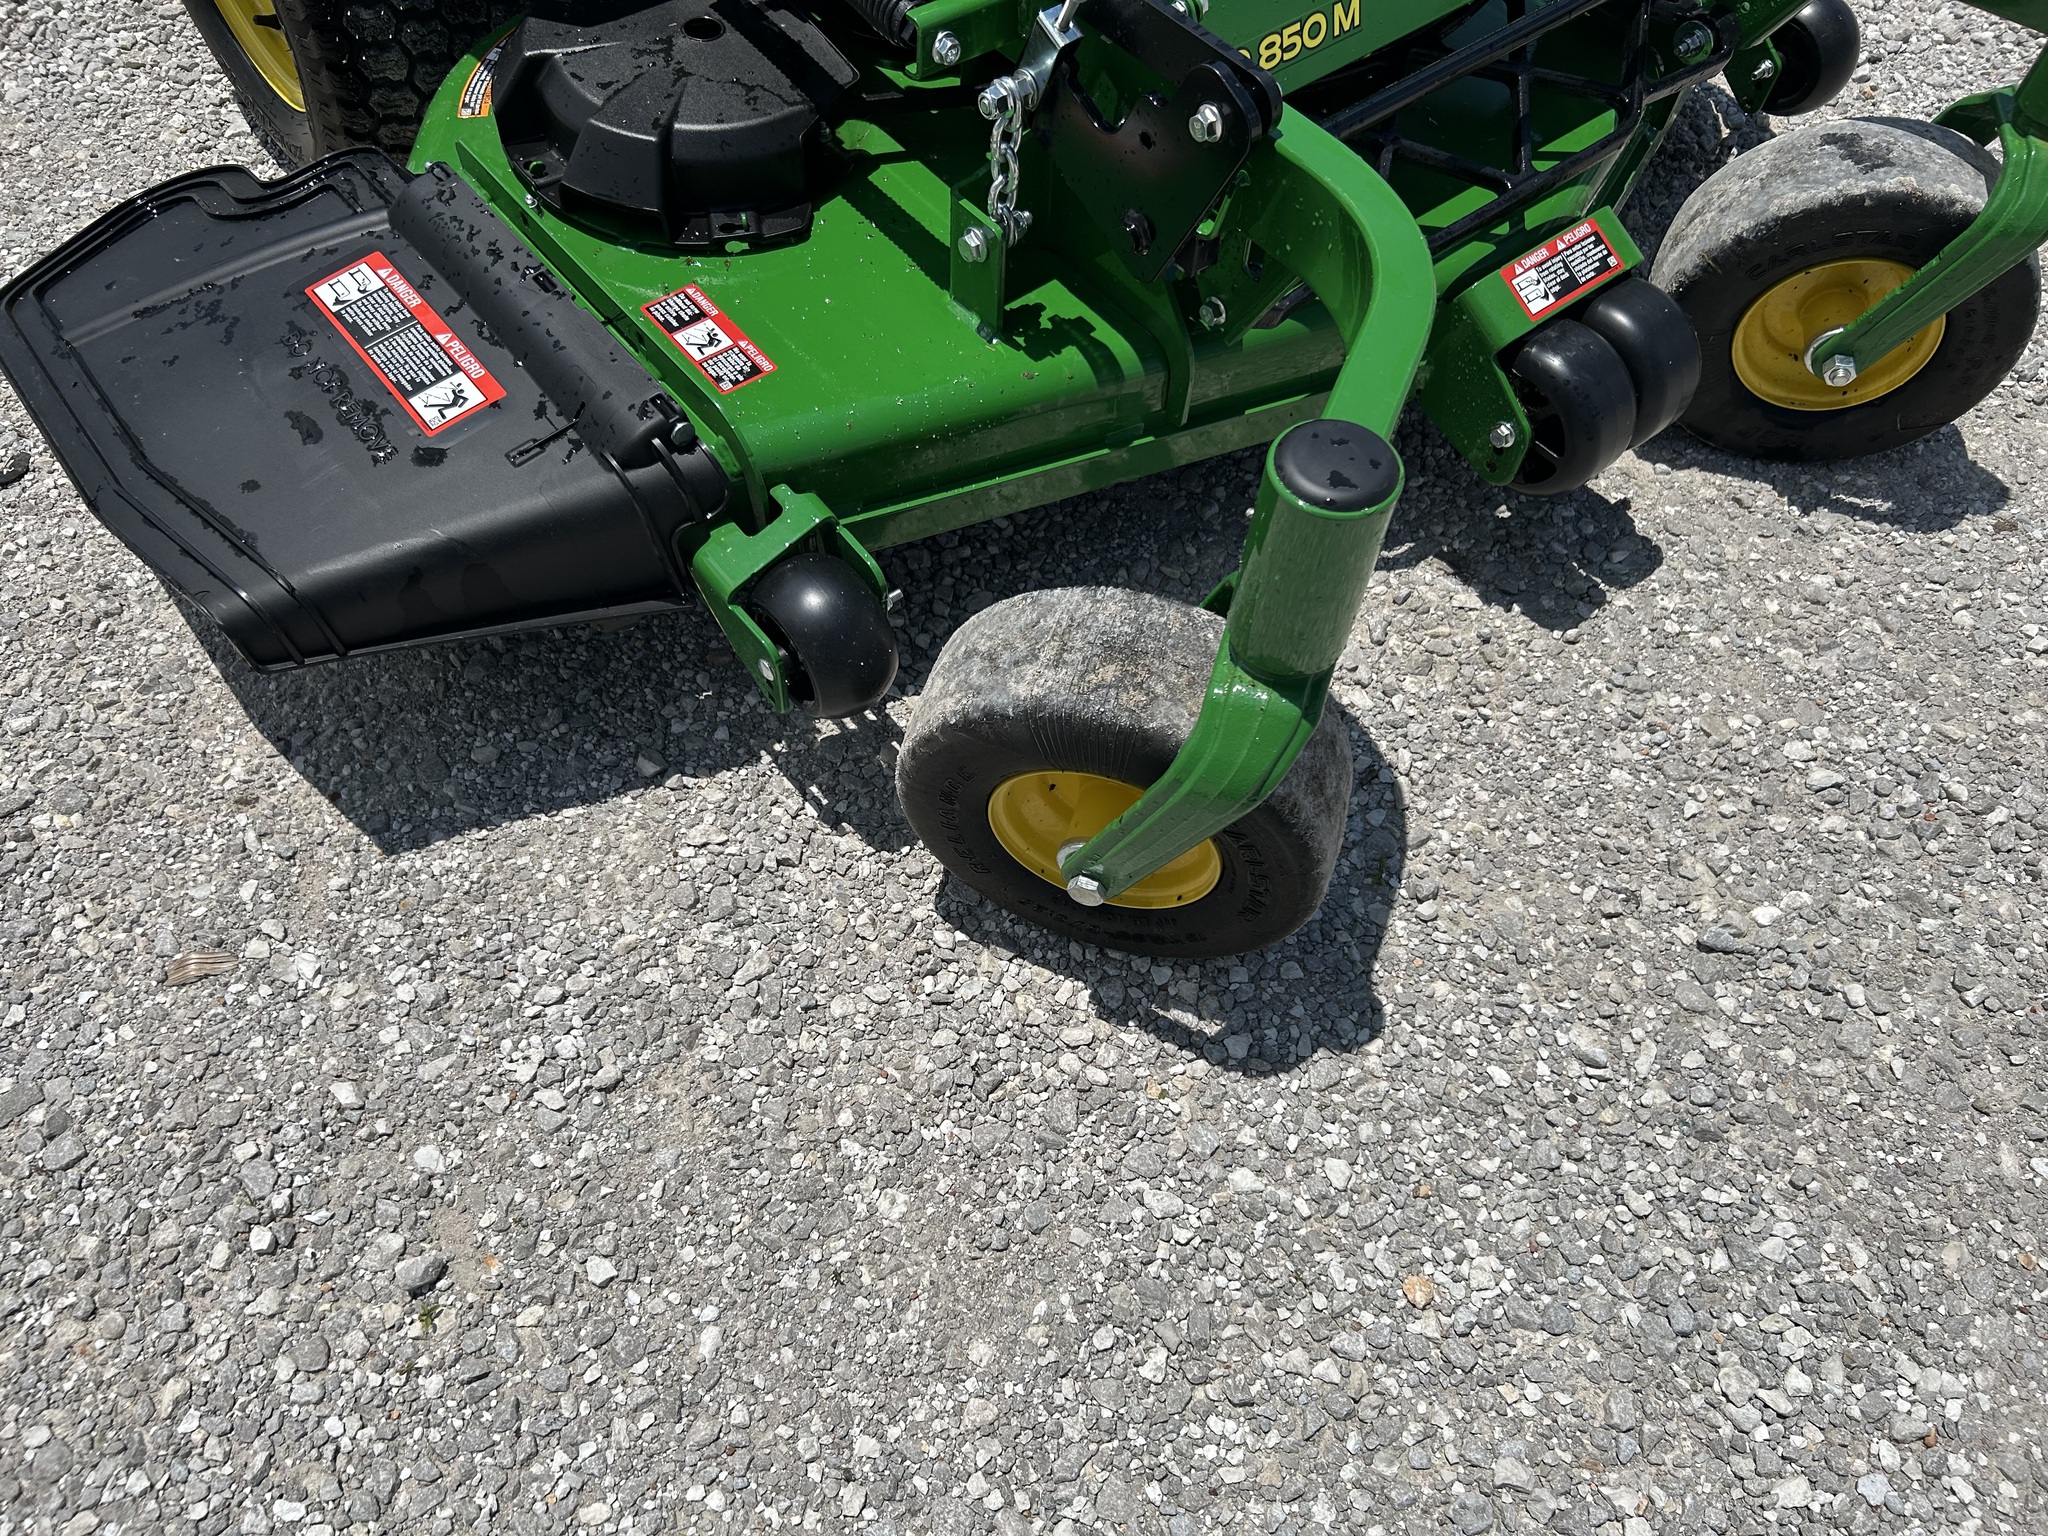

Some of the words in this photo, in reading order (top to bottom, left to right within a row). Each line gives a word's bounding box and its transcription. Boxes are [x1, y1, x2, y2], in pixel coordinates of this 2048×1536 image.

[1520, 247, 1549, 268] DANGER
[1562, 222, 1592, 244] PELIGRO
[385, 273, 422, 308] DANGER
[444, 339, 486, 379] PELIGRO
[690, 291, 719, 316] DANGER
[742, 344, 774, 372] PELIGRO
[281, 331, 311, 357] DO
[332, 391, 399, 463] REMOVE
[938, 766, 991, 874] RELIANCE
[1222, 822, 1271, 923] ARLSTAR
